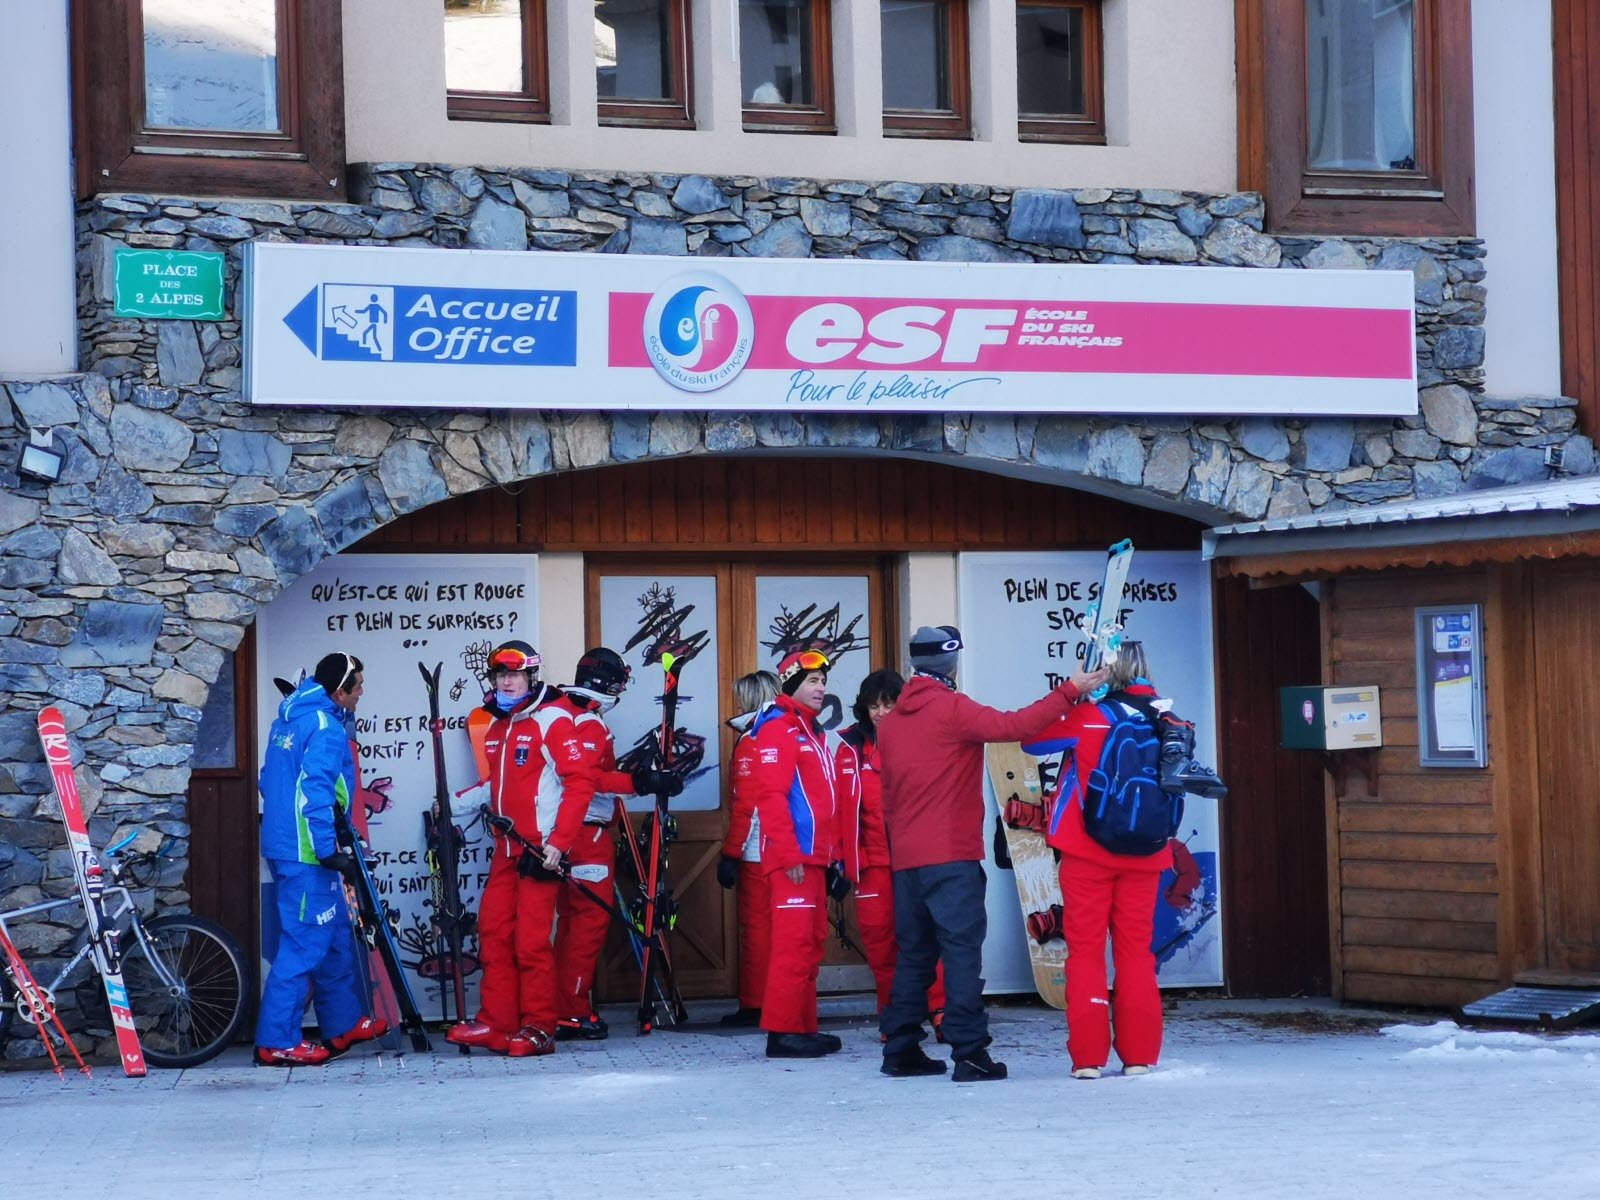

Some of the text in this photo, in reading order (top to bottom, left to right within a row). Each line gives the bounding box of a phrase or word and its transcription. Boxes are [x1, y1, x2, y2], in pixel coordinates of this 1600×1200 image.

[142, 264, 198, 277] PLACE
[159, 281, 181, 290] DES
[135, 293, 204, 306] 2 ALPES
[404, 293, 560, 322] Accueil
[1024, 307, 1088, 321] ÉCOLE
[1021, 322, 1095, 334] DU SKI
[407, 325, 536, 360] Office
[1017, 335, 1123, 349] FRANÇAIS
[649, 335, 672, 371] école
[708, 337, 749, 384] français
[786, 368, 1002, 406] Pour le plaisir
[311, 577, 398, 602] QU'EST-CE
[436, 584, 468, 602] EST
[474, 582, 525, 601] ROUGE
[1055, 581, 1082, 602] DE
[326, 615, 349, 632] ET
[400, 614, 422, 631] DE
[1047, 641, 1068, 659] ET
[384, 716, 413, 733] EST
[316, 903, 337, 926] HEY
